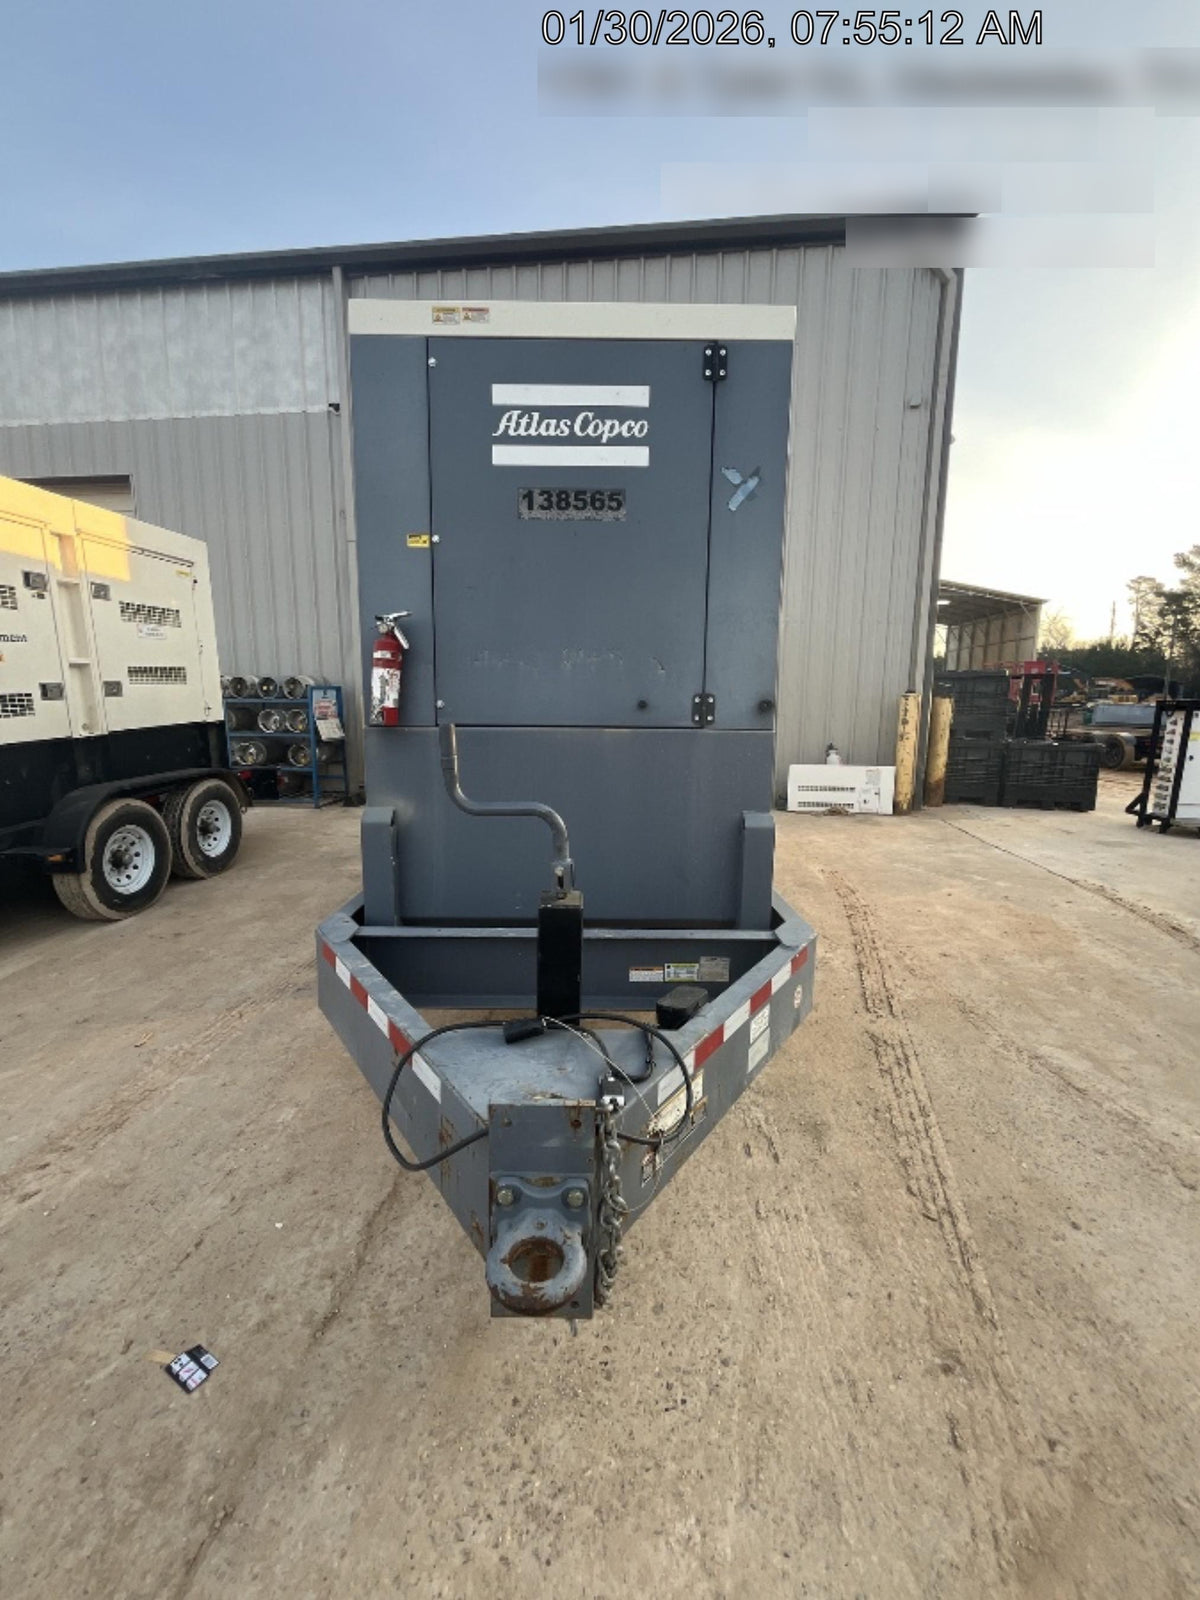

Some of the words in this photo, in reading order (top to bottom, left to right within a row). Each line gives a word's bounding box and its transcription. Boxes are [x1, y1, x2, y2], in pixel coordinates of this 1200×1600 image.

[492, 410, 571, 437] Atlas
[573, 411, 649, 443] Copco
[521, 490, 623, 511] 138565
